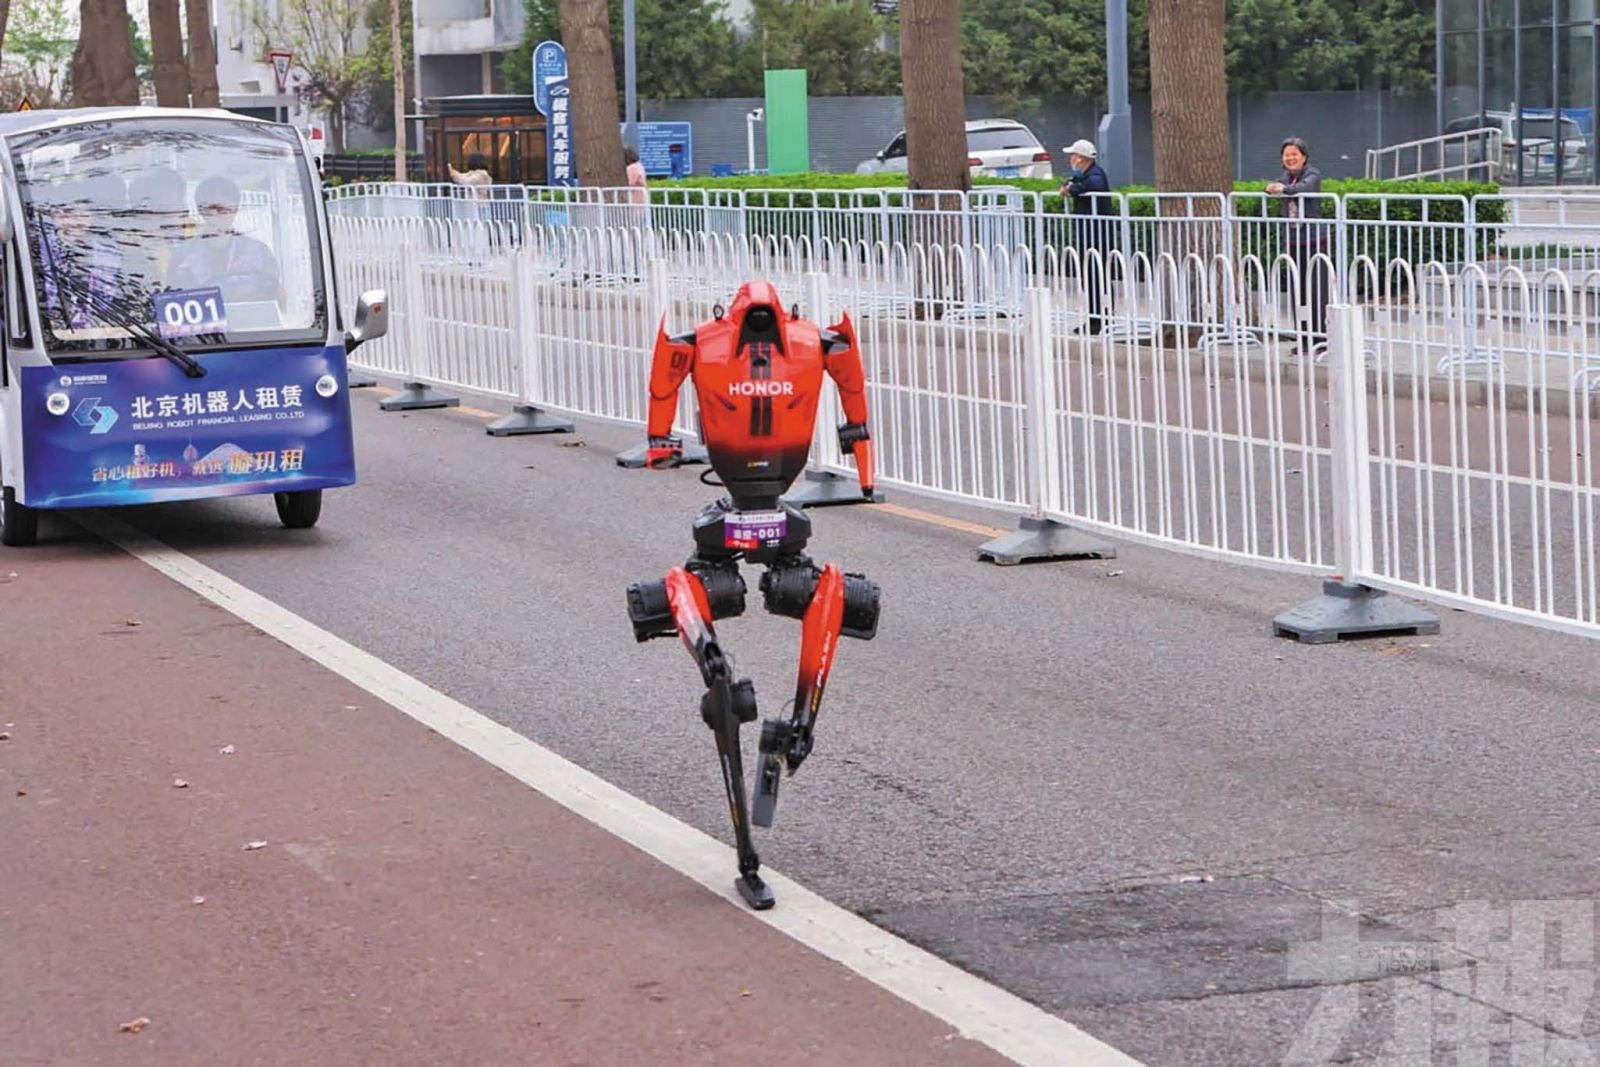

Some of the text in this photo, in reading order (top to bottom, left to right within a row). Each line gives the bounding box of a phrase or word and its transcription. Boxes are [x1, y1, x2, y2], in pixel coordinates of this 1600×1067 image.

[164, 298, 219, 326] 001
[729, 382, 793, 396] HONOR
[131, 385, 303, 419] 北京机器人租赁
[133, 422, 164, 430] BEIJING
[167, 420, 194, 428] ROBOT
[197, 416, 236, 425] FINANCIAL
[239, 413, 272, 422] LEASING
